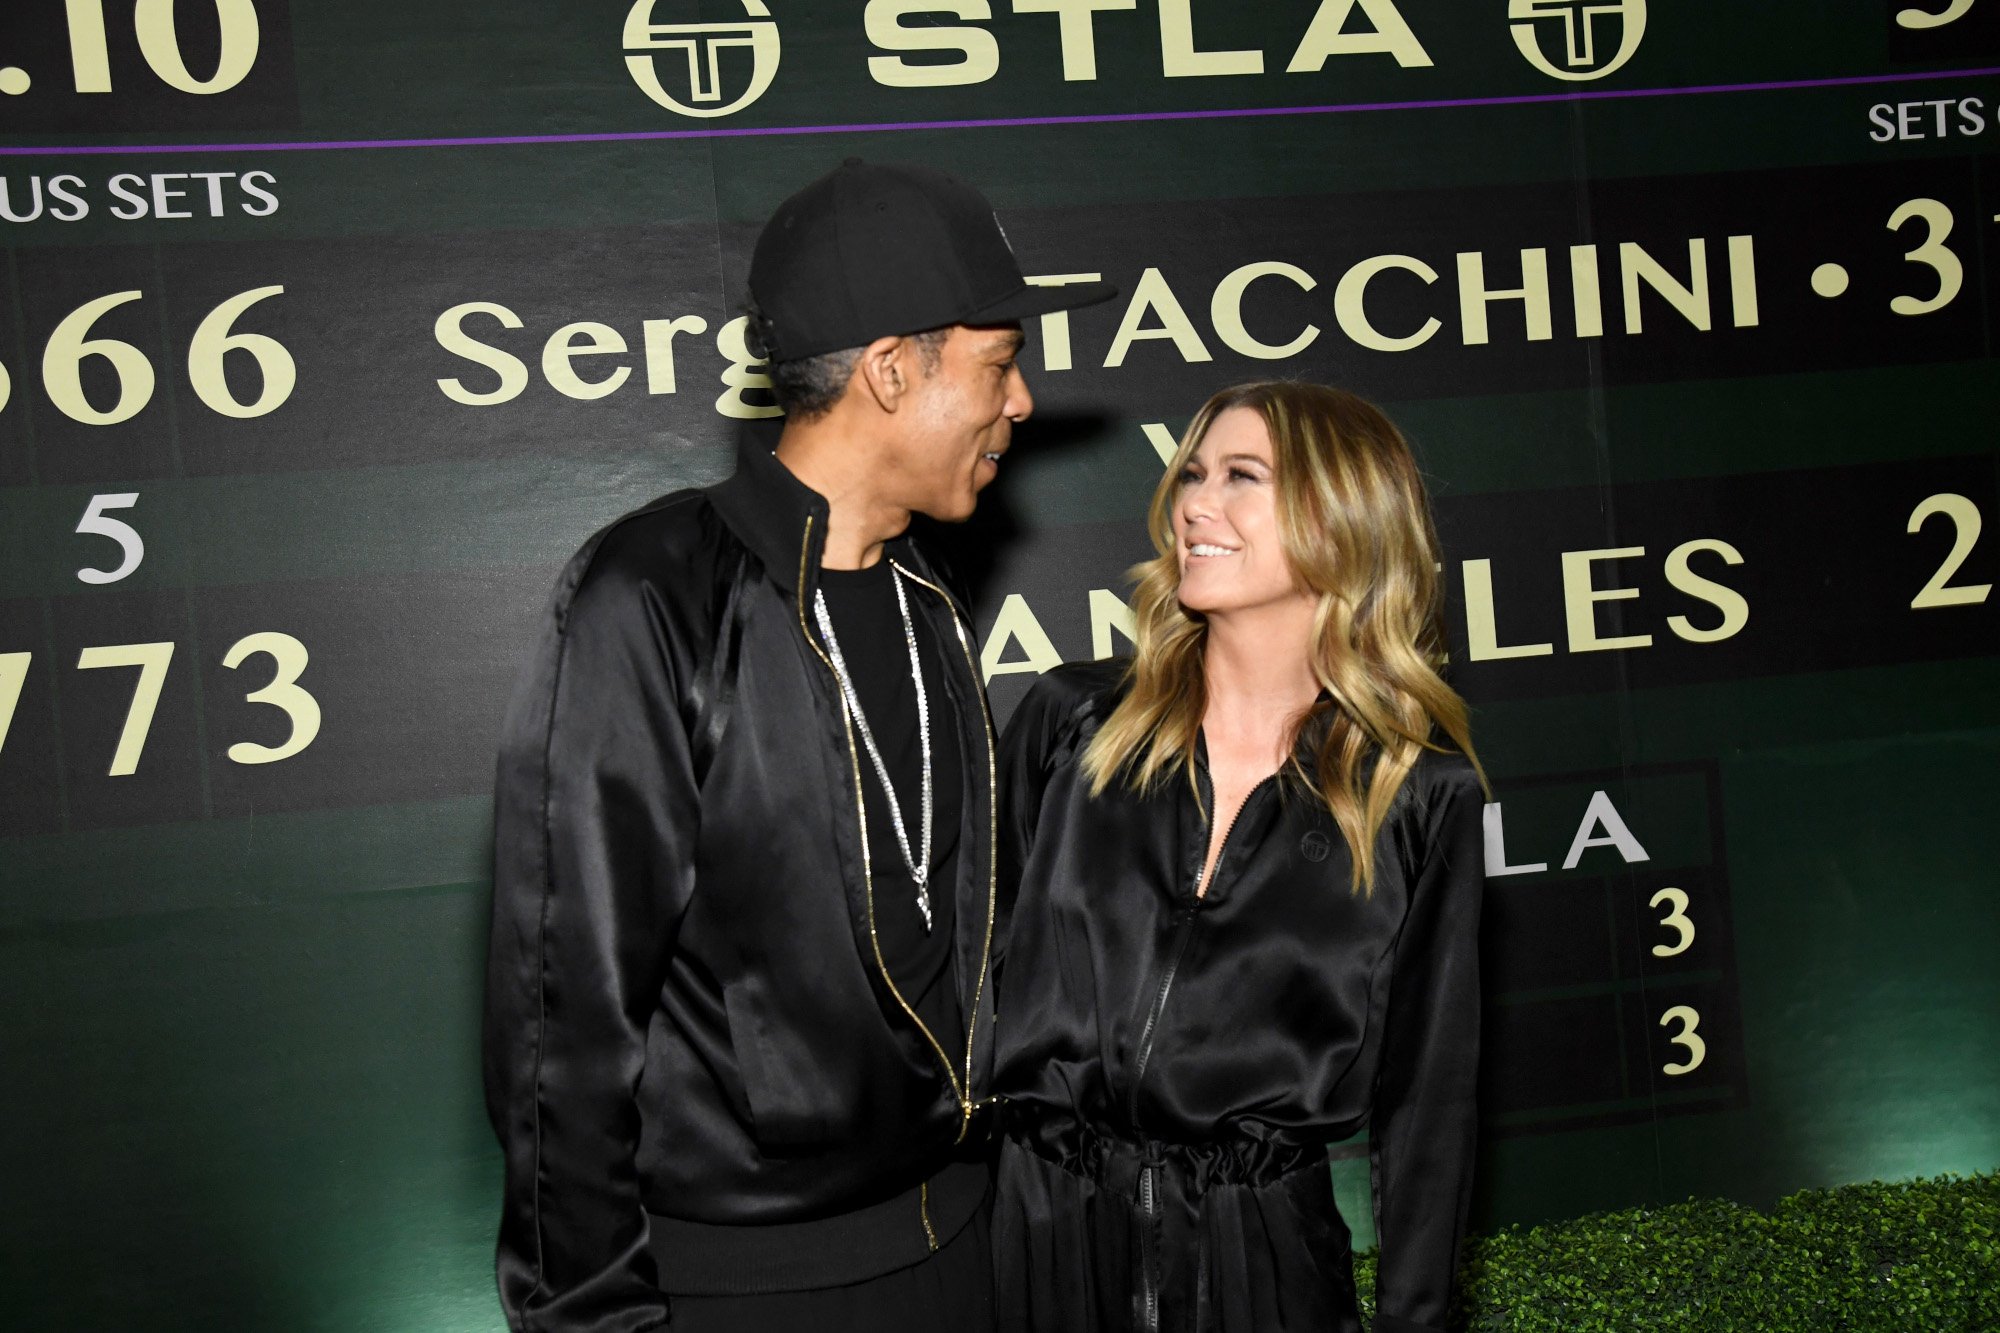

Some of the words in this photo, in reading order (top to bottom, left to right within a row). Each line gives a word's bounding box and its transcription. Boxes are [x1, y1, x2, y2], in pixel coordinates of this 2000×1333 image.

[864, 0, 1435, 88] STLA
[1868, 97, 1986, 142] SETS
[108, 170, 279, 220] SETS
[1886, 198, 1964, 316] 3
[434, 302, 786, 419] Serg
[1022, 234, 1760, 373] TACCHINI
[76, 492, 145, 585] 5
[1907, 493, 1994, 610] 2
[1648, 887, 1696, 958] 3
[1658, 1005, 1707, 1076] 3
